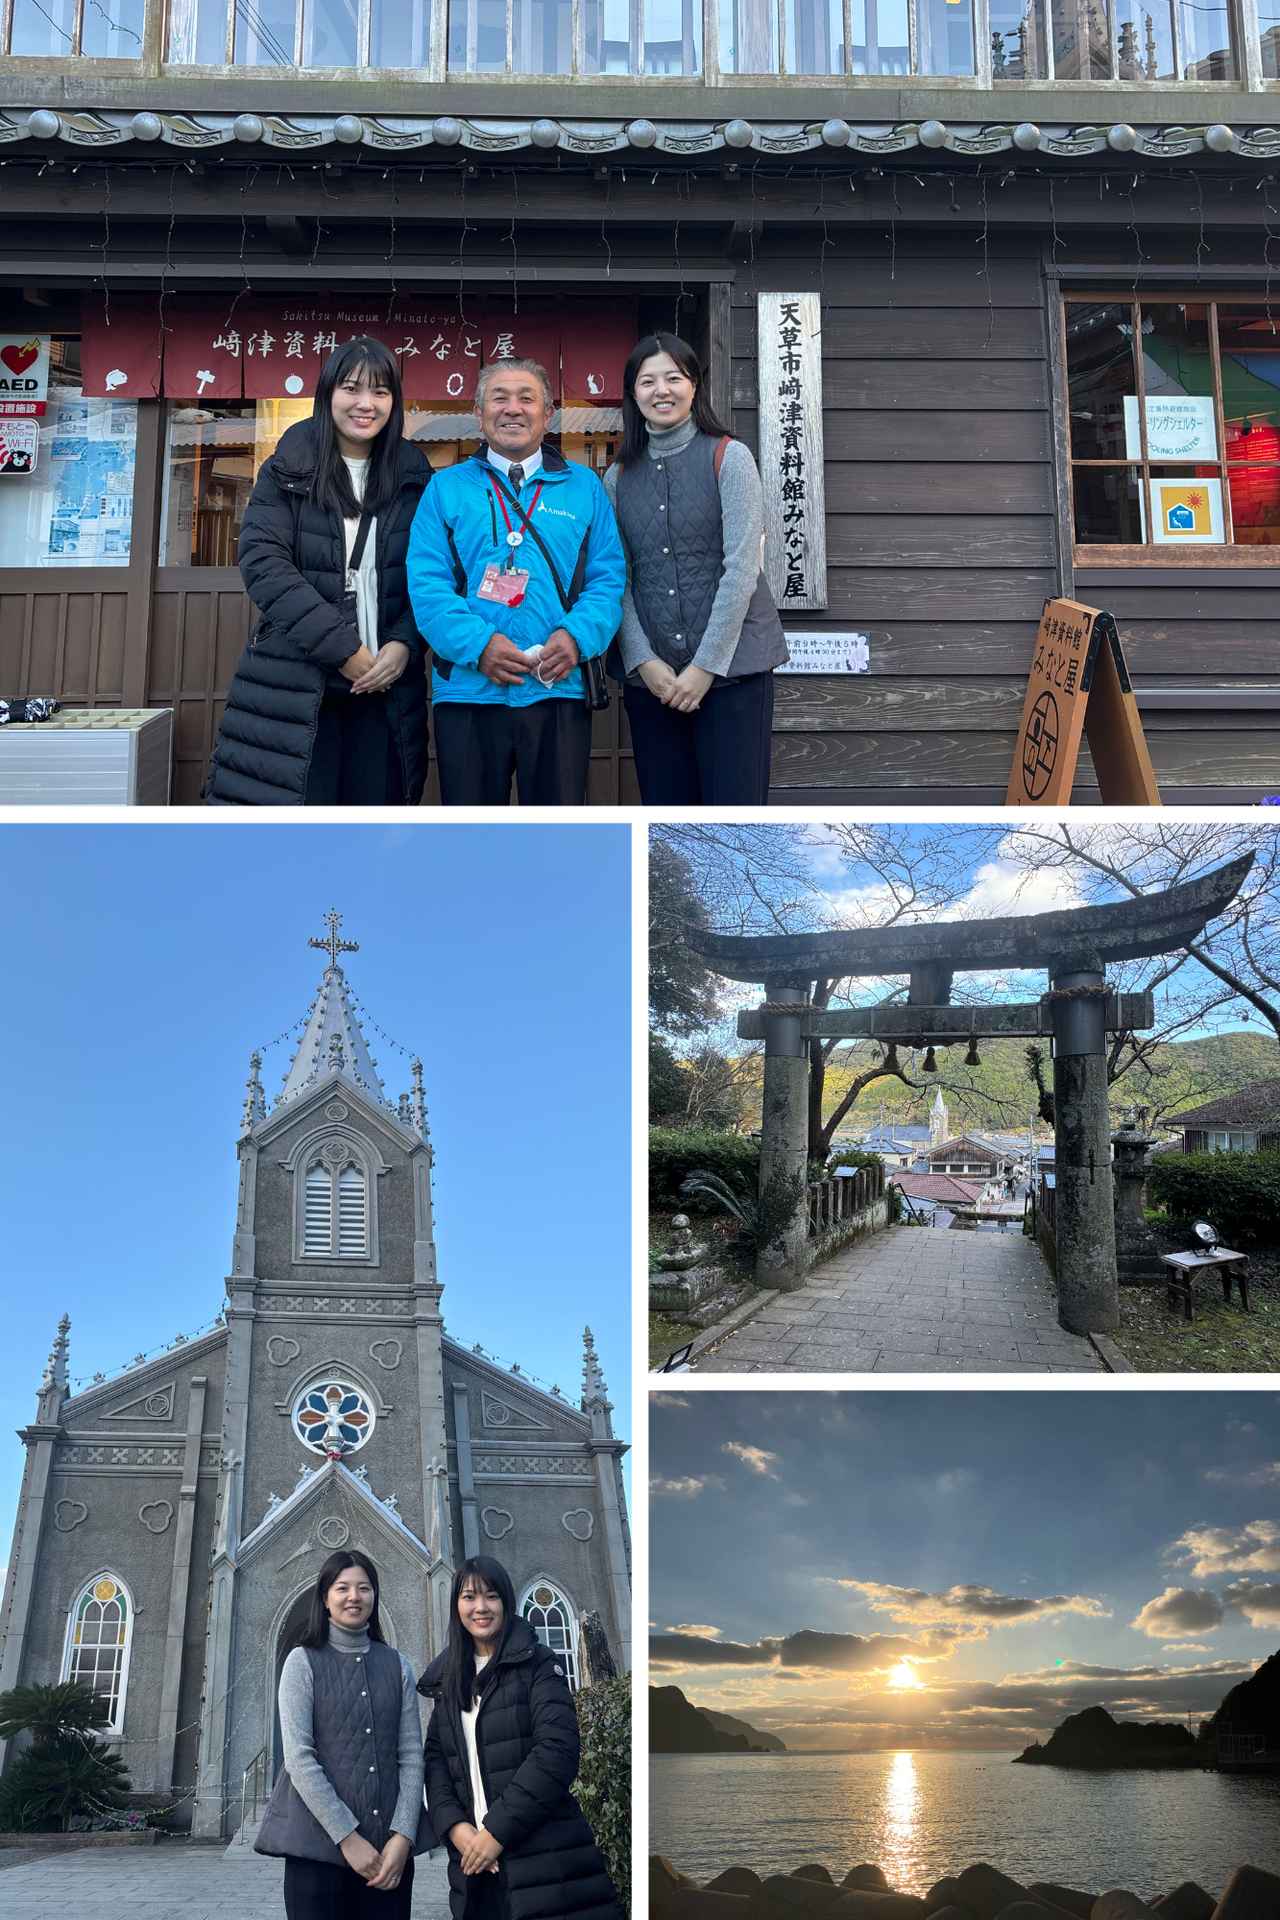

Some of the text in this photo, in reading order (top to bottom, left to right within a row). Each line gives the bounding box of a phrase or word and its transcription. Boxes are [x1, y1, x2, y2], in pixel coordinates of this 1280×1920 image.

[281, 310, 330, 321] Sakitsu
[336, 311, 380, 322] Museum
[0, 378, 39, 391] AED
[1138, 415, 1203, 431] リングシェルター
[1034, 645, 1079, 696] みなと屋
